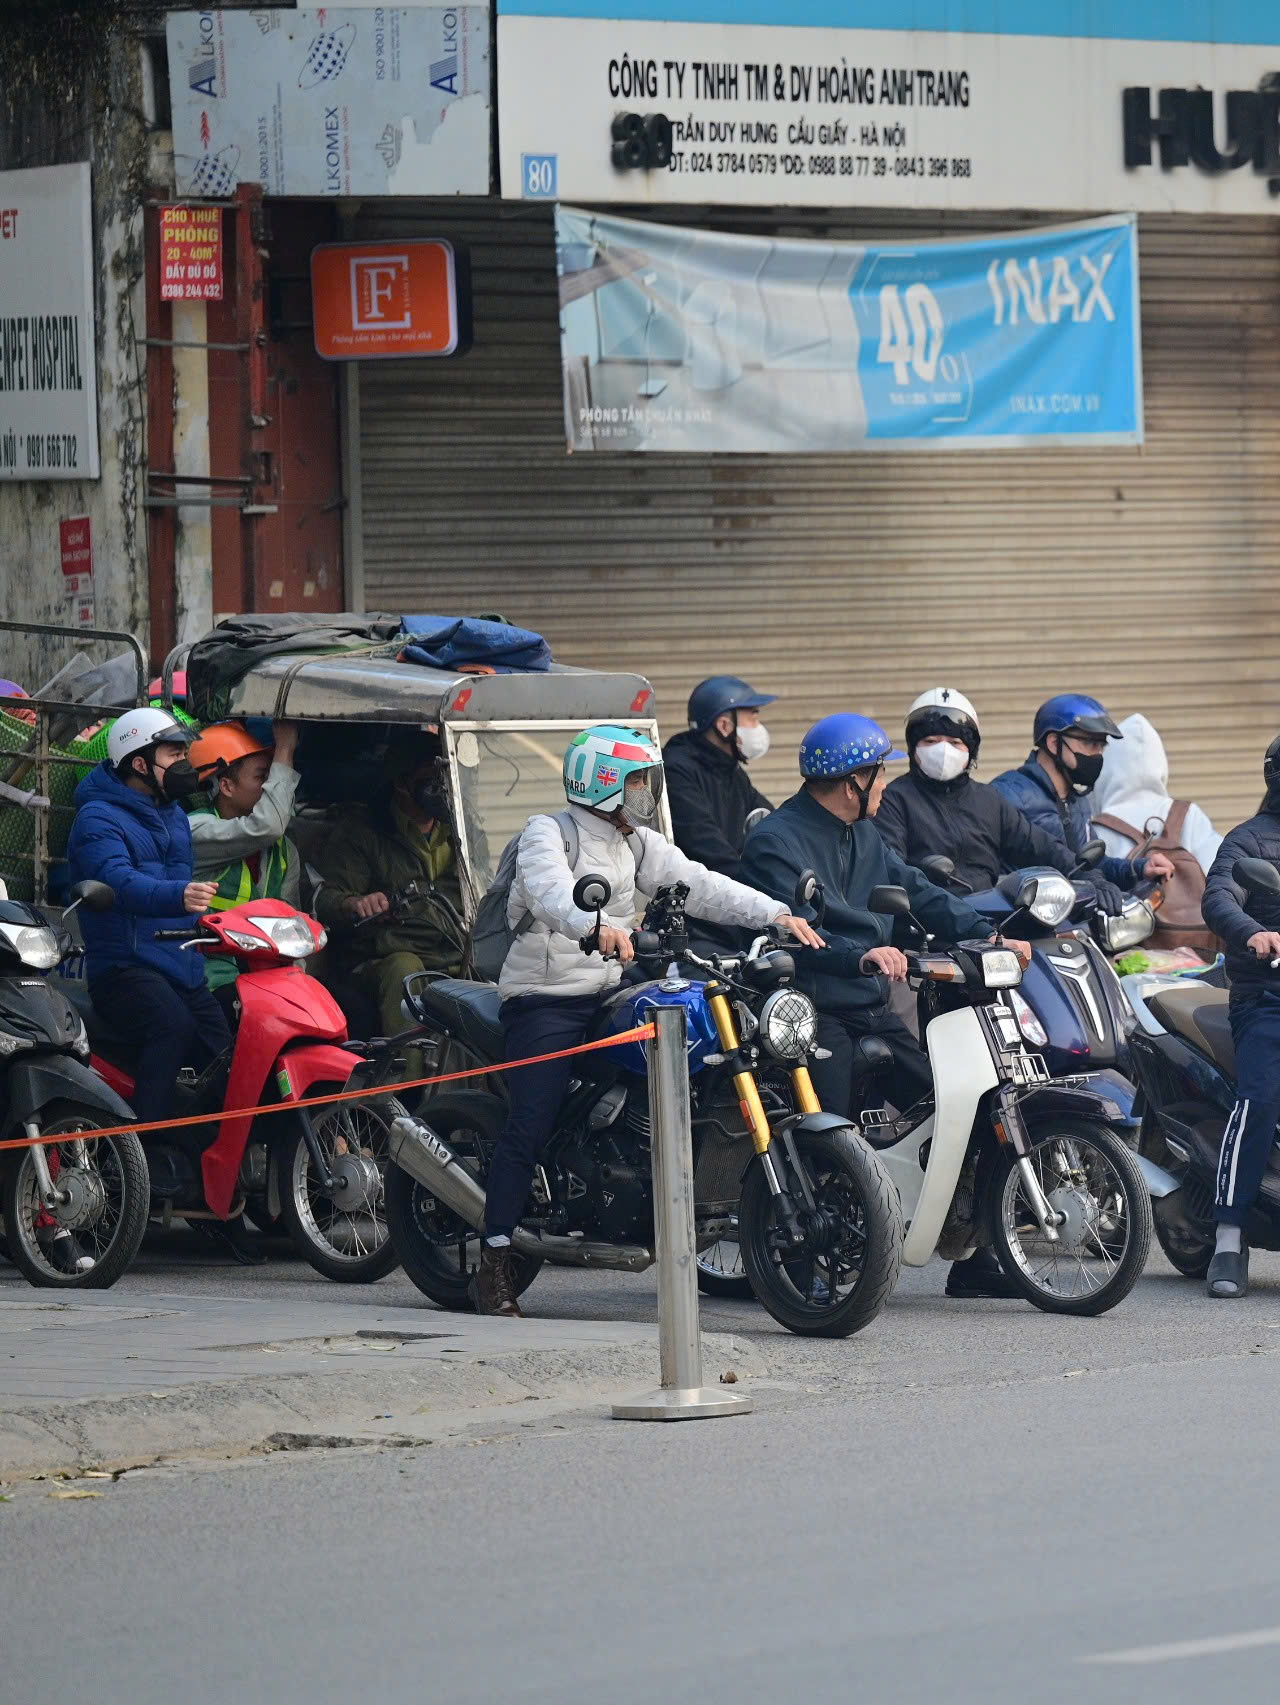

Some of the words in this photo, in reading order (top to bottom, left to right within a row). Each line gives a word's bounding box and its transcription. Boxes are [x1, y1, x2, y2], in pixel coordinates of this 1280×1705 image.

[608, 52, 658, 98] CÔNG
[664, 61, 686, 99] TY
[692, 62, 738, 100] TNHH
[744, 63, 768, 101] TM
[774, 63, 785, 101] &
[790, 64, 812, 103] DV
[818, 56, 875, 105] HOÀNG
[879, 68, 914, 106] ANH
[917, 70, 970, 108] TRANG
[611, 111, 673, 170] 80
[709, 121, 736, 143] DUY
[818, 118, 849, 145] GIẤY
[861, 121, 879, 147] HÀ
[883, 122, 906, 152] NỘI
[528, 159, 553, 193] 80
[690, 152, 713, 173] 024
[716, 153, 746, 173] 3784
[749, 154, 777, 174] 0579
[856, 156, 870, 176] 77
[164, 209, 188, 223] CHO
[191, 203, 218, 223] THUÊ
[167, 247, 181, 261] 20
[986, 253, 1116, 325] INAX
[31, 315, 82, 391] HOSPITAL
[579, 405, 619, 423] PHÒNG
[26, 434, 45, 469] 0981
[46, 434, 61, 468] 666
[62, 434, 77, 468] 702
